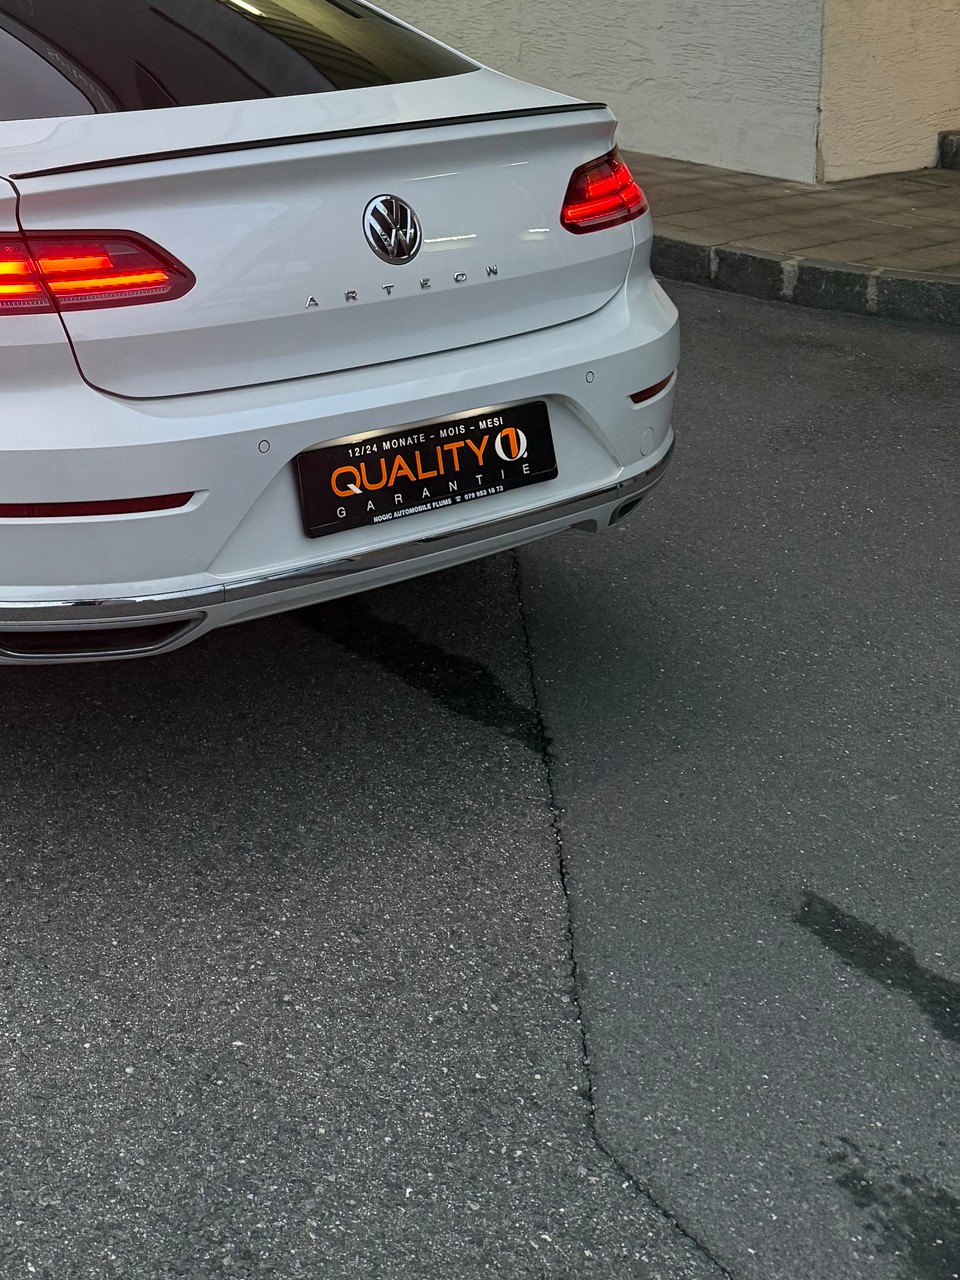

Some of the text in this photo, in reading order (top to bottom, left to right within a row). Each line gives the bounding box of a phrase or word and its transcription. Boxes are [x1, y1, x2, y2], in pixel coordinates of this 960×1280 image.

[304, 264, 498, 308] ARTEON
[348, 443, 378, 458] 12/24
[383, 433, 426, 451] MONATE
[440, 424, 466, 438] MOIS
[479, 416, 504, 430] MESI
[331, 435, 490, 497] QUALITY
[336, 463, 530, 518] GARANTIE
[393, 504, 432, 518] AUTOMOBILE
[432, 498, 452, 509] FLUMS
